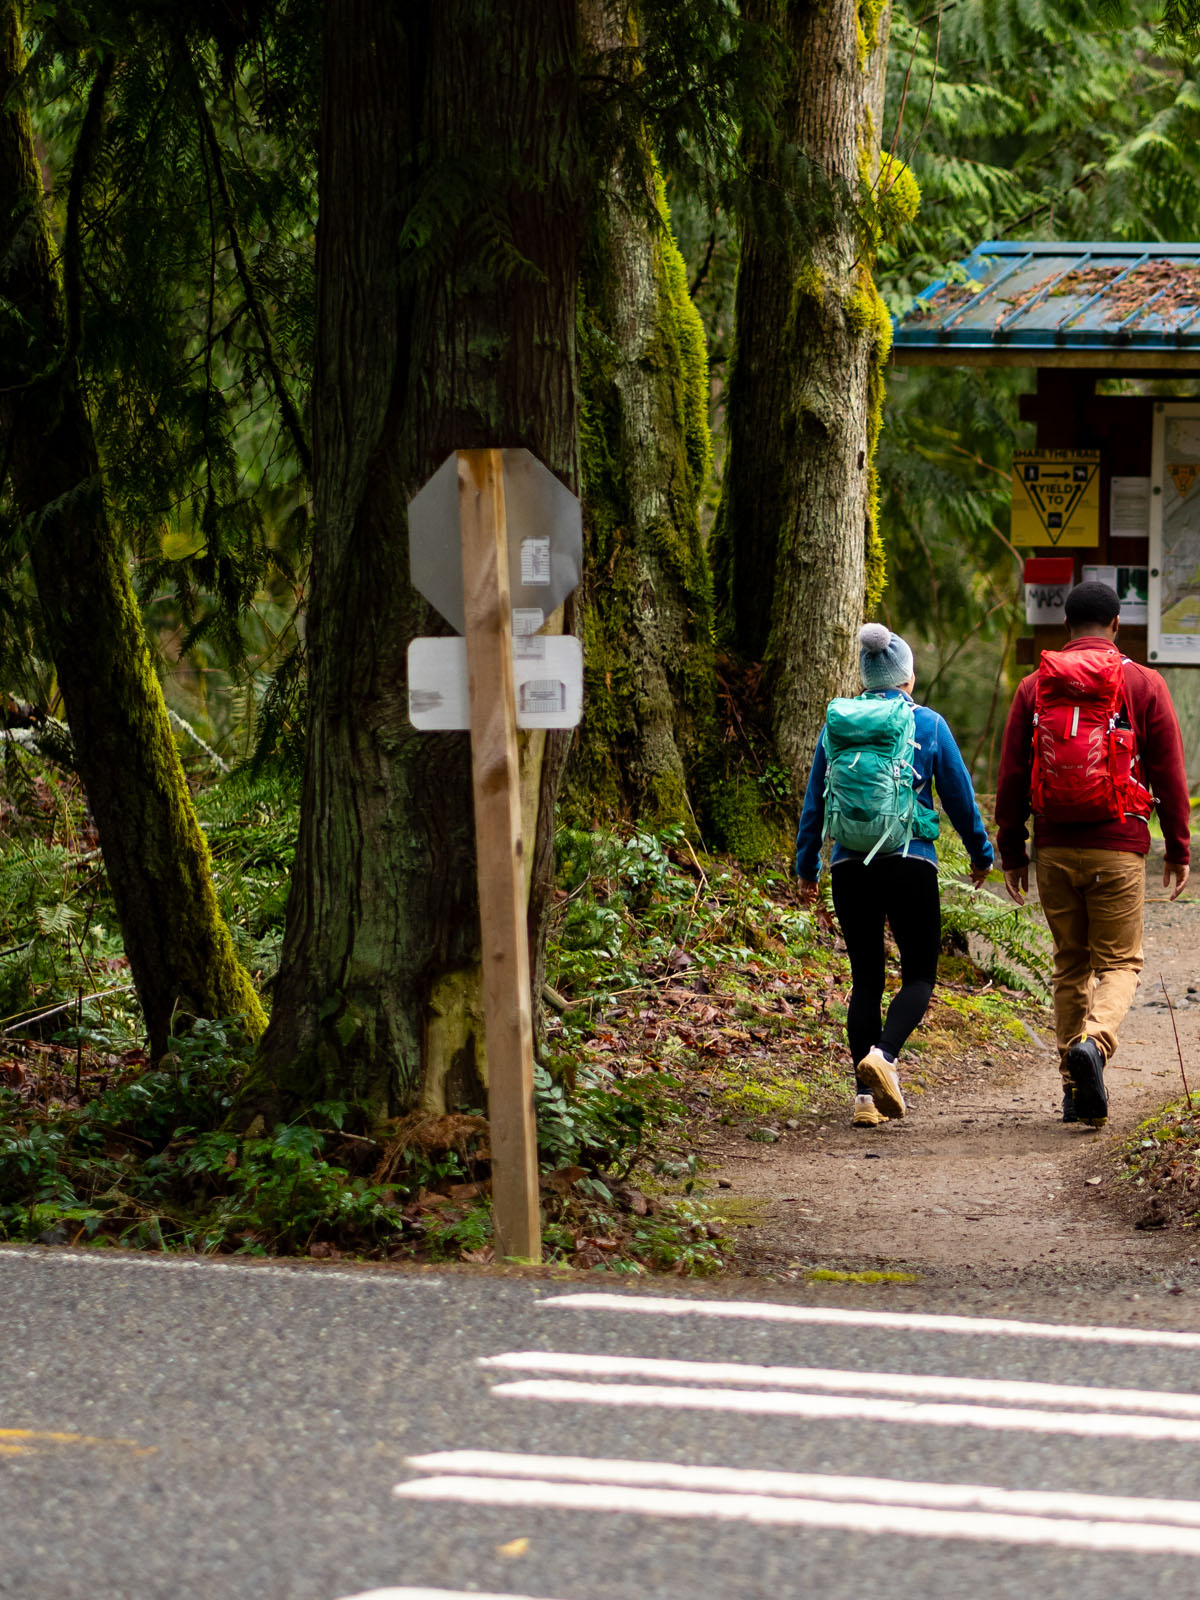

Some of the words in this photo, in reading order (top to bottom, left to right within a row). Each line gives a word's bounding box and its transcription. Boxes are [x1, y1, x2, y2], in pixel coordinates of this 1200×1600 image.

[1049, 449, 1067, 458] THE
[1068, 449, 1099, 458] TRAIL
[1038, 484, 1073, 493] YIELD
[1047, 495, 1064, 504] TO
[1028, 587, 1064, 609] MAPS
